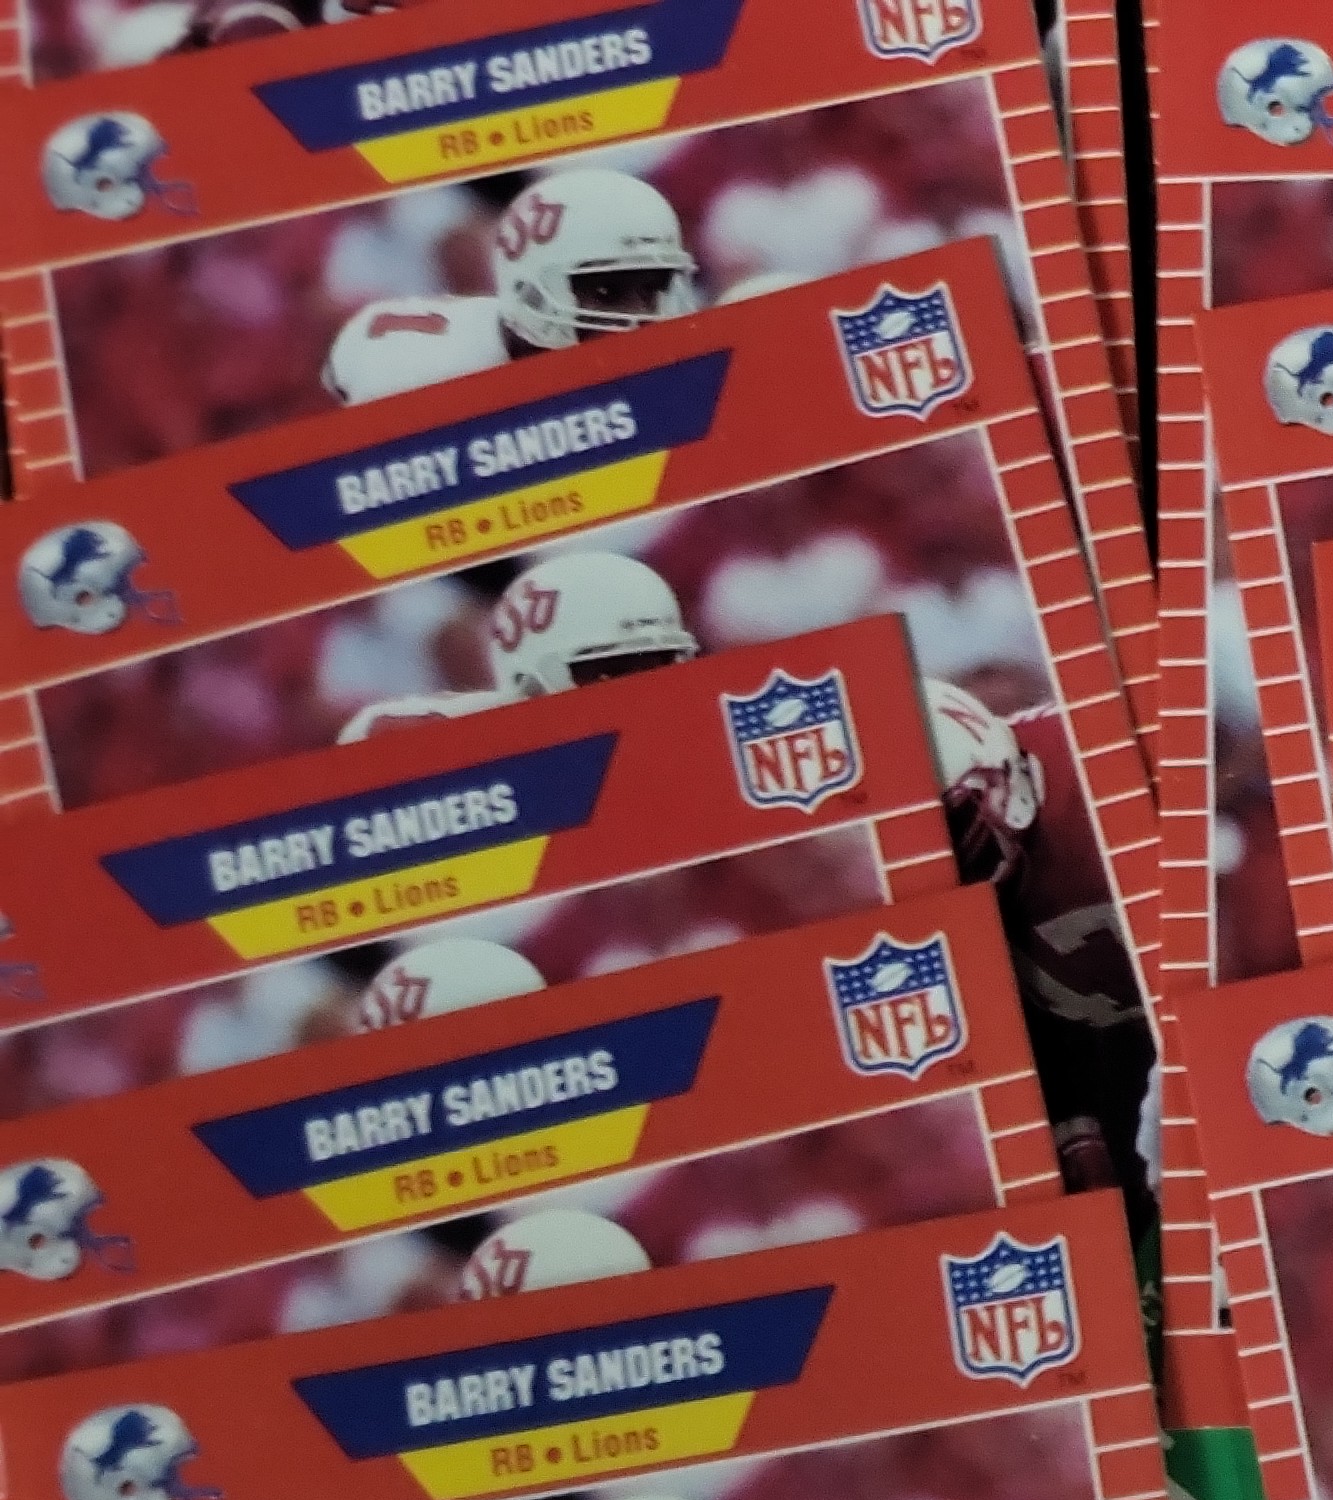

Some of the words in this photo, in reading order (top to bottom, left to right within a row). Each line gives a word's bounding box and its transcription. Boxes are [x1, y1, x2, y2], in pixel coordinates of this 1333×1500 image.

[873, 0, 970, 48] NFL
[356, 62, 479, 121] BARRY
[485, 27, 652, 93] SANDERS
[438, 129, 480, 159] RB
[513, 111, 594, 145] Lions
[860, 337, 957, 403] NFL
[335, 447, 458, 515] BARRY
[467, 400, 637, 477] SANDERS
[424, 518, 467, 550] RB
[501, 492, 583, 530] Lions
[751, 729, 849, 793] NFL
[208, 824, 334, 892] BARRY
[343, 783, 518, 858] SANDERS
[296, 899, 339, 932] RB
[374, 876, 458, 915] Lions
[853, 993, 950, 1059] NFL
[304, 1092, 432, 1162] BARRY
[442, 1049, 618, 1127] SANDERS
[393, 1168, 438, 1203] RB
[473, 1145, 559, 1185] Lions
[966, 1296, 1065, 1364] NFL
[405, 1364, 536, 1427] BARRY
[546, 1333, 725, 1401] SANDERS
[489, 1443, 536, 1478] RB
[571, 1427, 661, 1464] Lions
